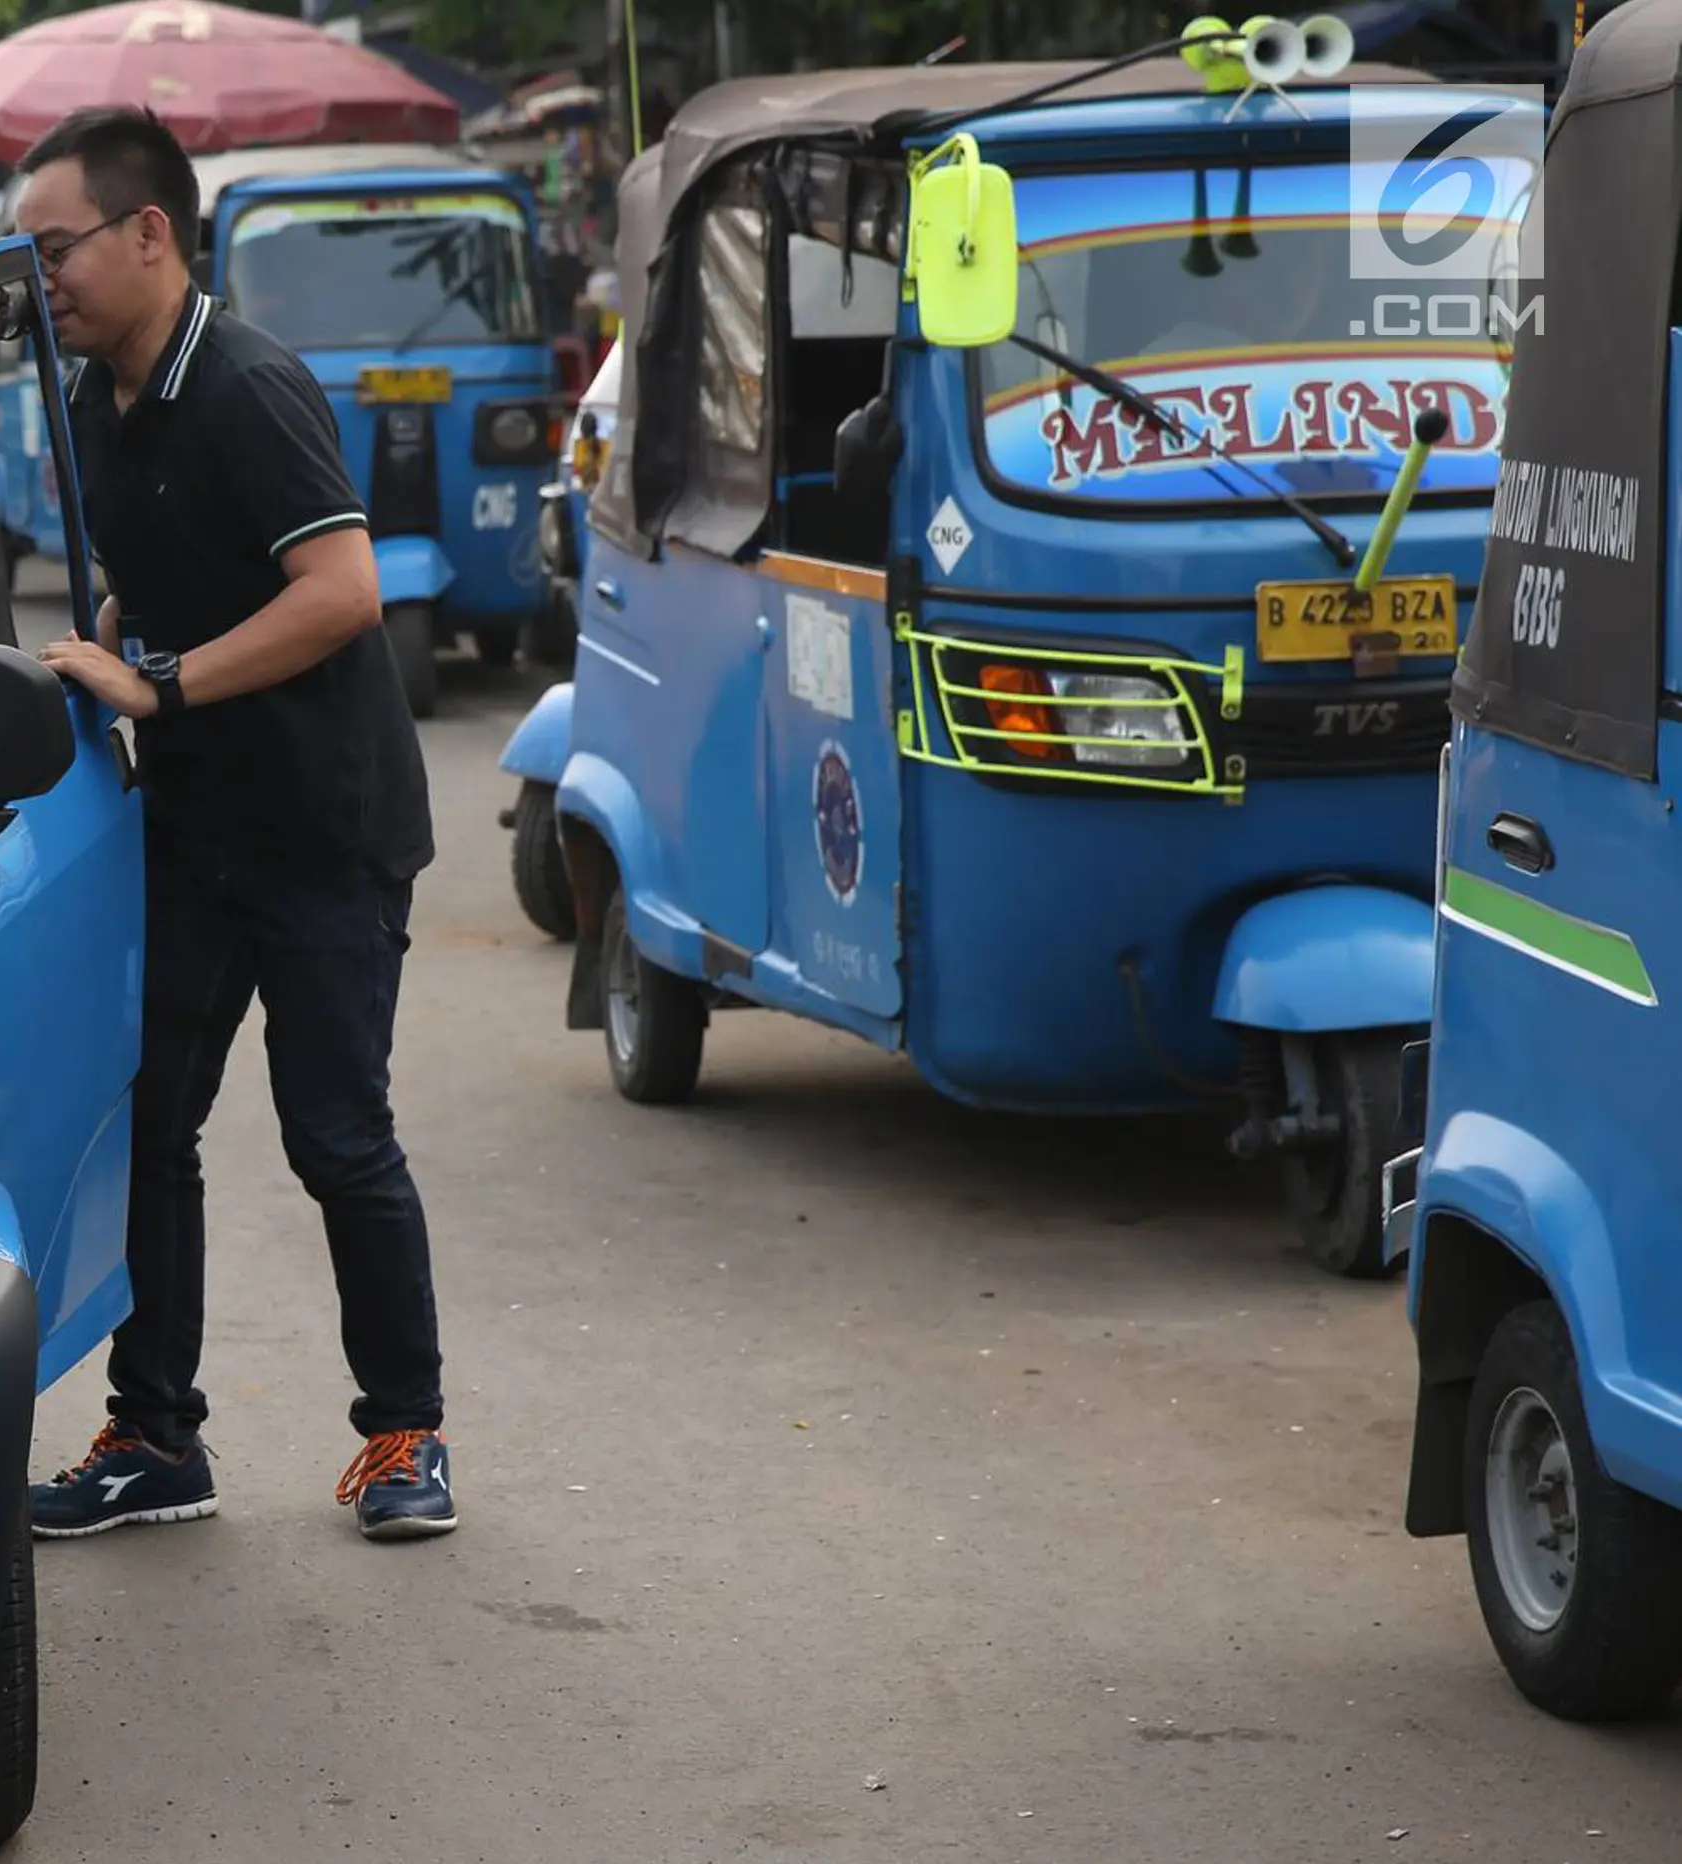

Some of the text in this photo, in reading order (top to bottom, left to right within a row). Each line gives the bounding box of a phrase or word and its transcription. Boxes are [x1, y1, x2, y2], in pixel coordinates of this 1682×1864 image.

[1040, 378, 1504, 486] MELIND
[472, 481, 517, 531] CNG
[1545, 466, 1639, 563] LINGKUNGAN
[930, 526, 964, 546] CNG
[1269, 596, 1285, 627] B
[1391, 590, 1446, 622] BZA
[1513, 564, 1566, 650] BBG
[1313, 702, 1400, 736] TVS
